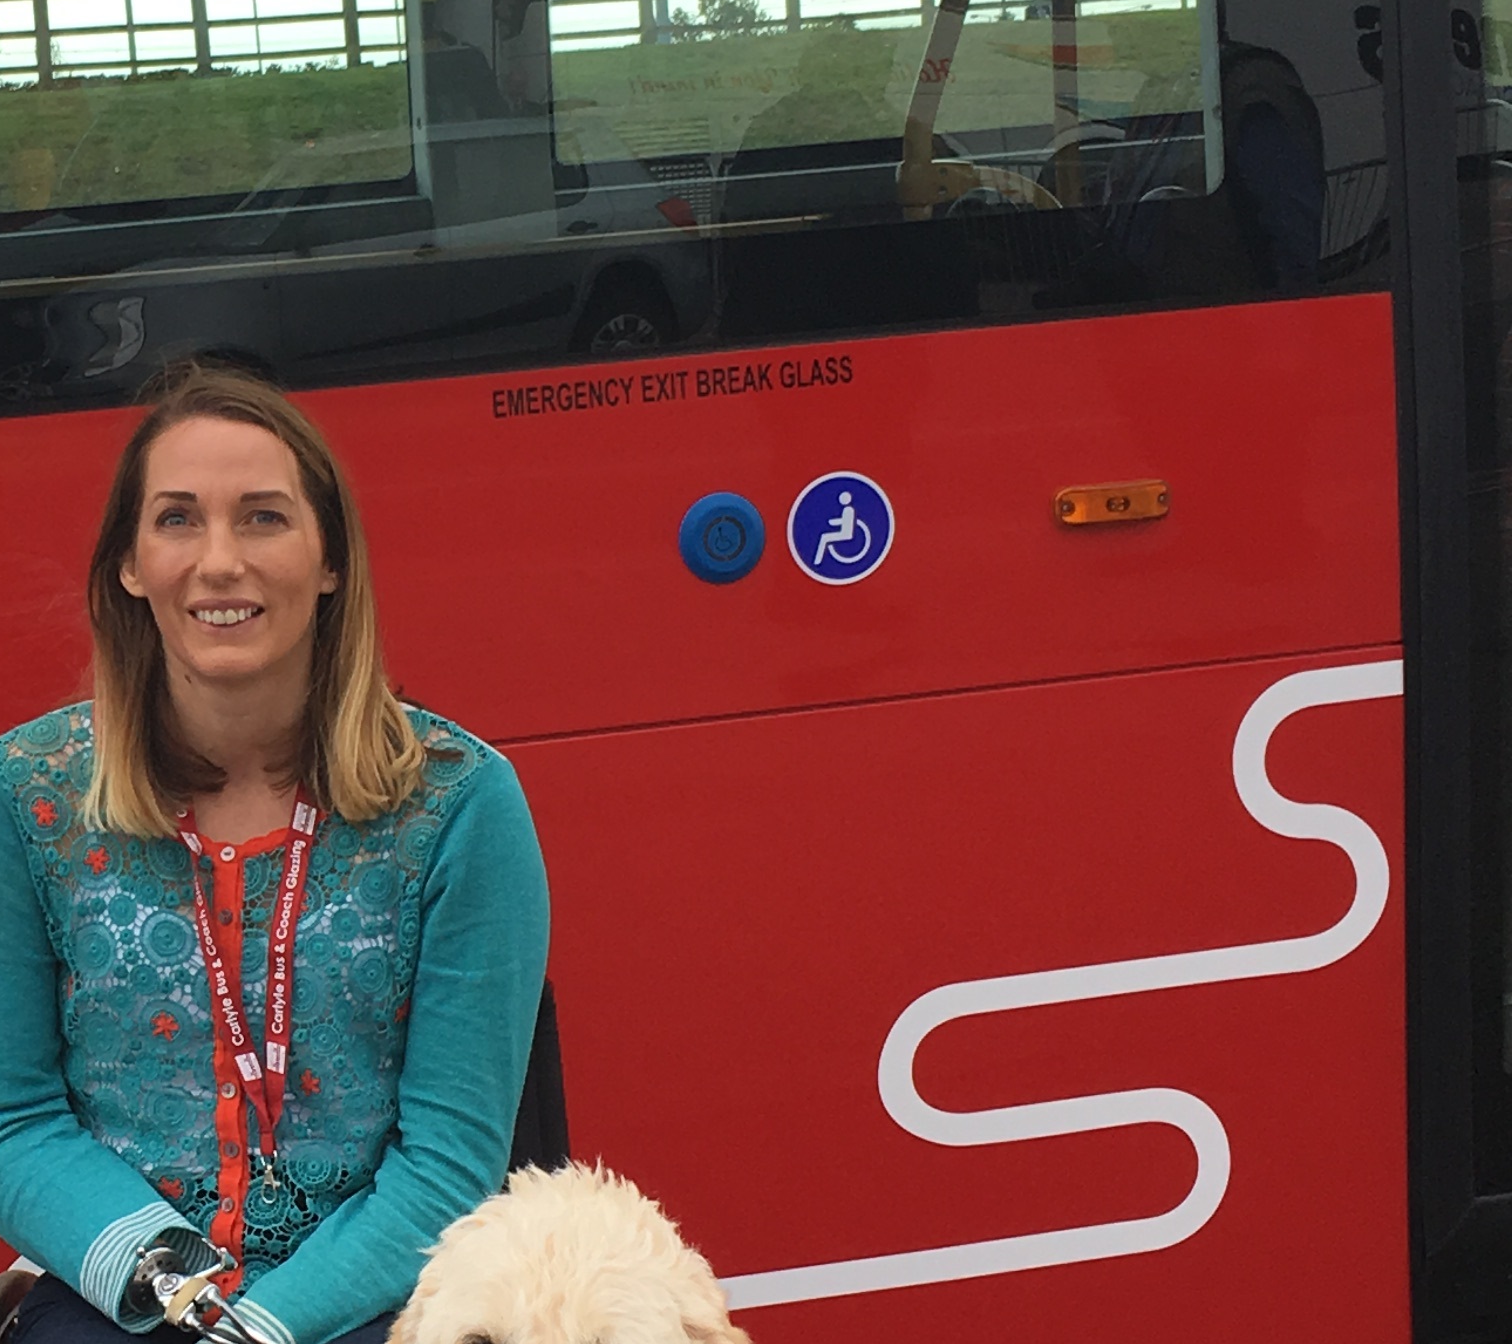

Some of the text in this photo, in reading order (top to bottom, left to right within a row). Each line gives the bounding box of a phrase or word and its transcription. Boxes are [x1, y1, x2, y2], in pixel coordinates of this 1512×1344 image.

[492, 355, 853, 419] EMERGENCY EXIT BREAK GLASS
[198, 908, 217, 957] Coach
[271, 839, 307, 1034] Carlyle Bus & Coach Glazing
[211, 957, 223, 969] &
[215, 970, 229, 996] Bus
[222, 997, 245, 1046] Carlyle
